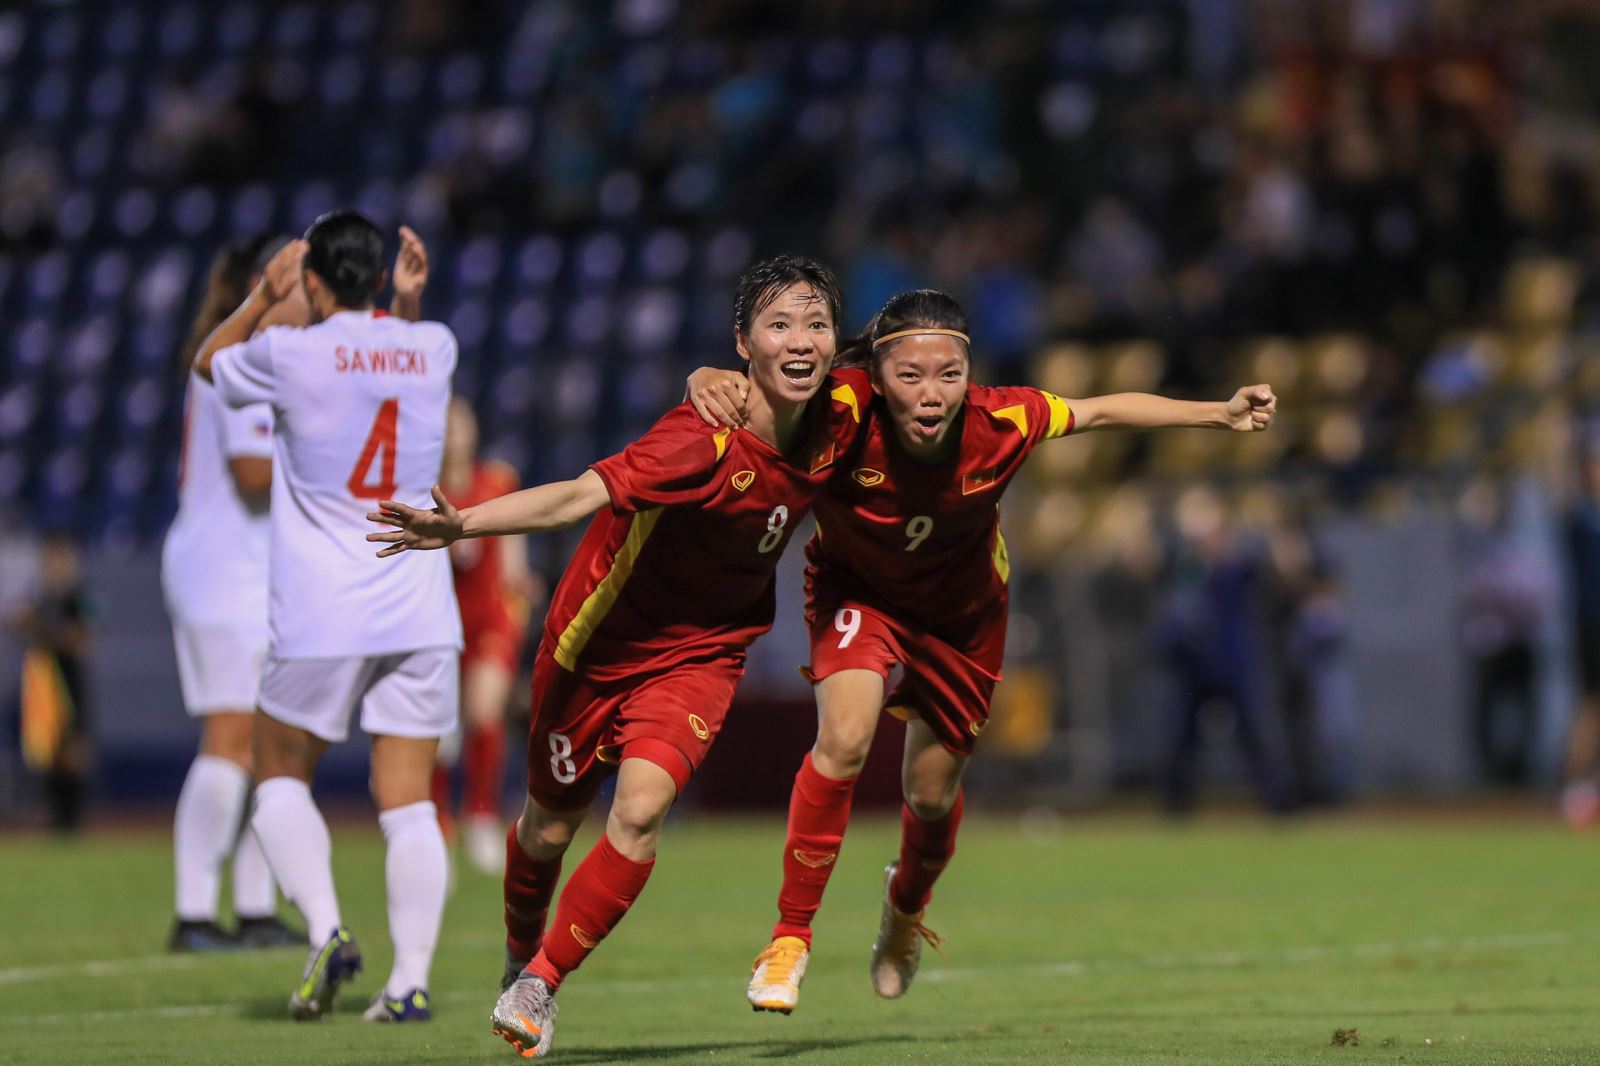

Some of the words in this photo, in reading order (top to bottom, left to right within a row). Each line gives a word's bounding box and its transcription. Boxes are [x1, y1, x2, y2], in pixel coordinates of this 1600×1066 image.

[335, 345, 427, 375] SAWICKI
[346, 398, 399, 527] 4
[758, 504, 788, 553] 8
[905, 515, 934, 552] 9
[834, 608, 861, 649] 9
[548, 732, 576, 784] 8
